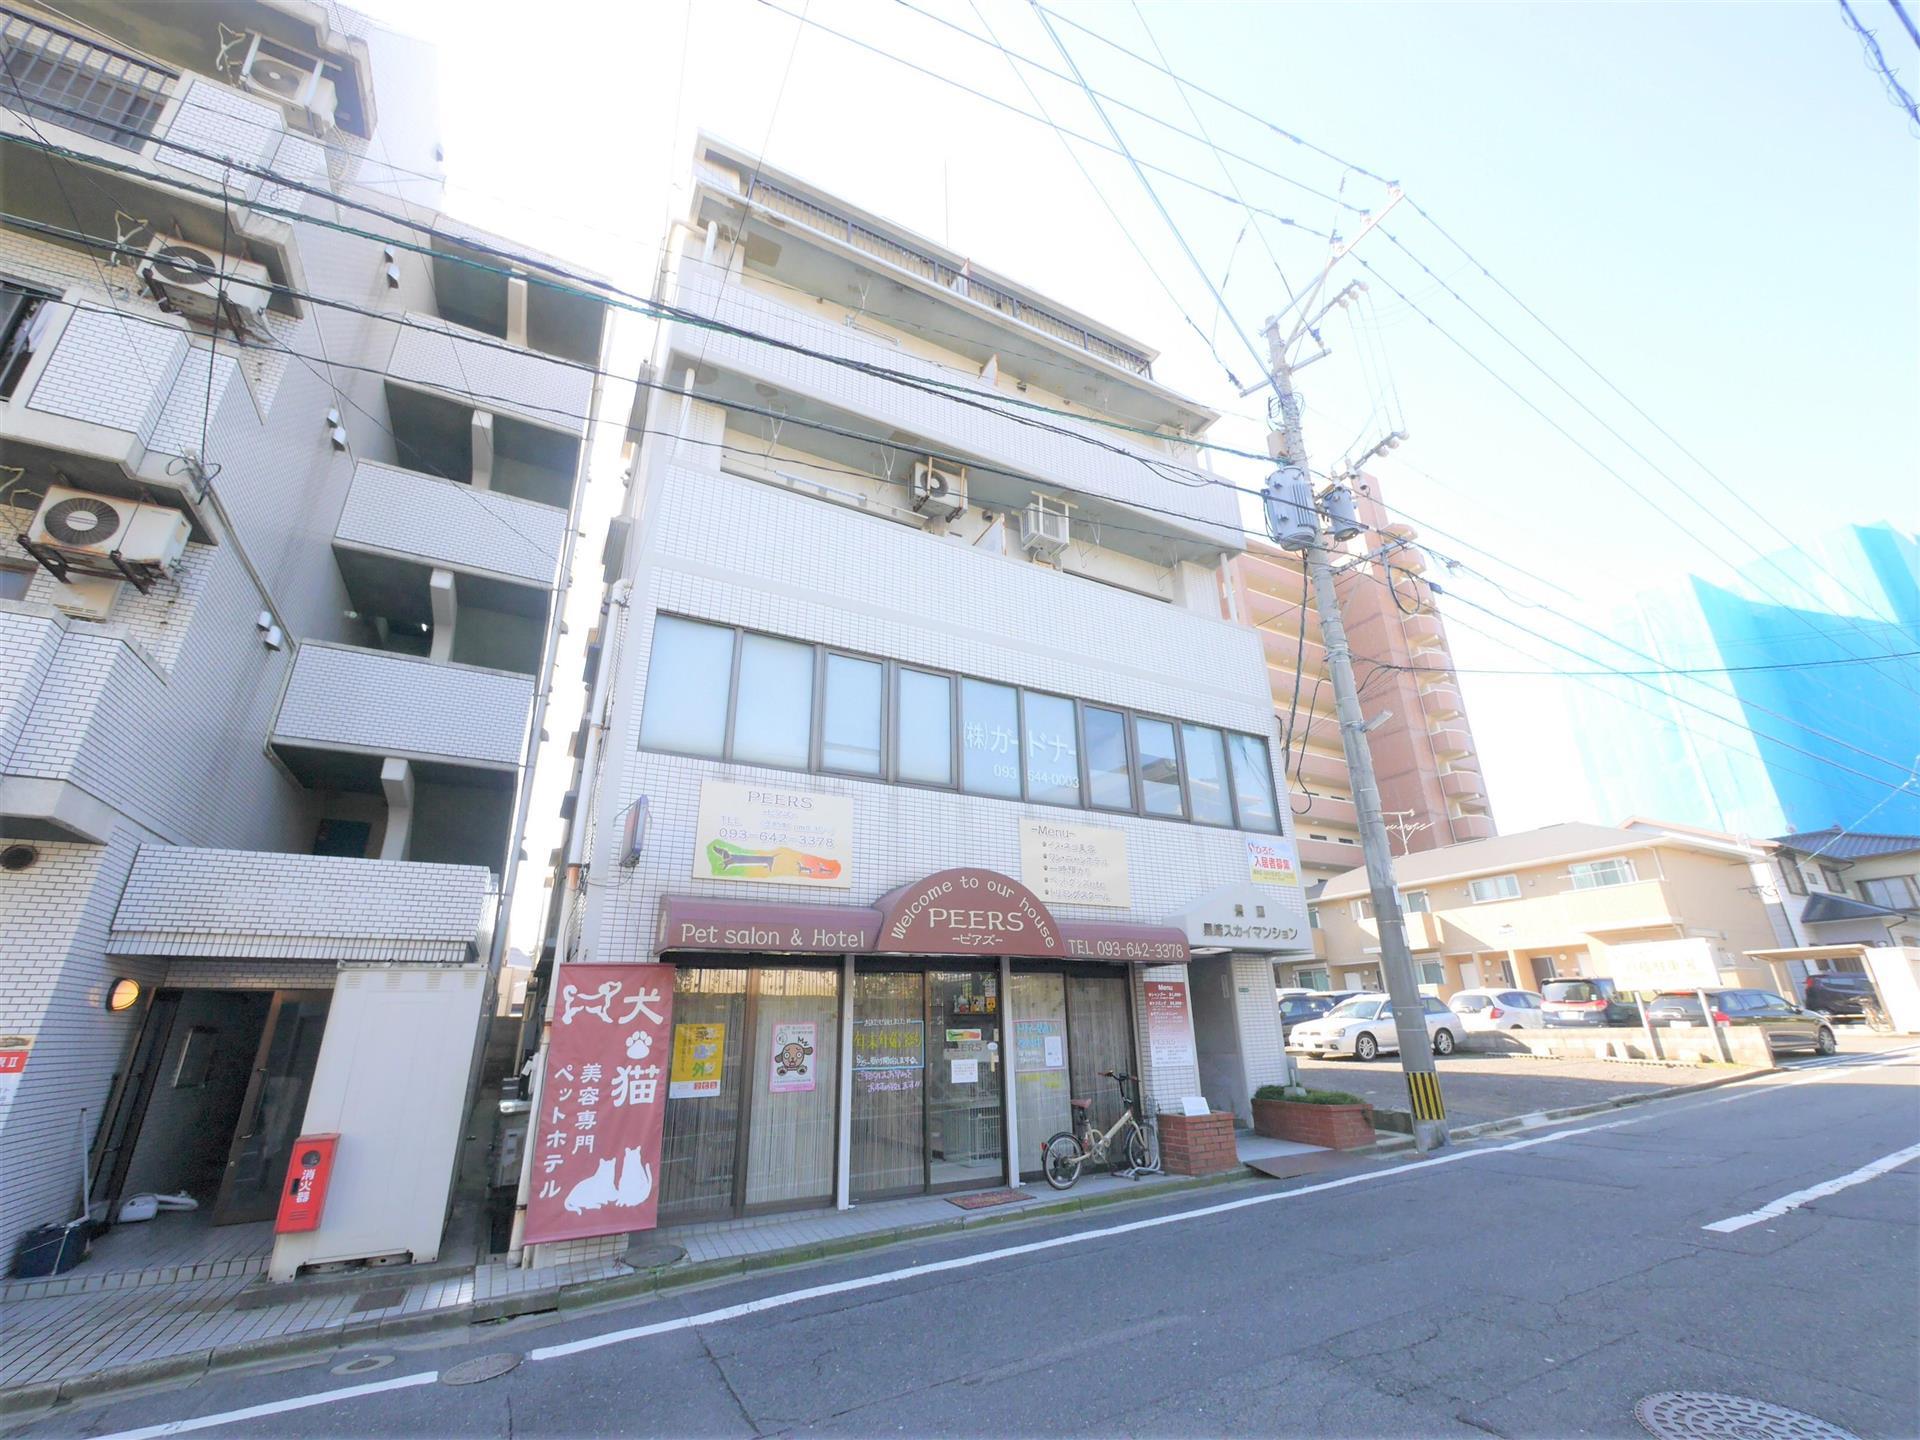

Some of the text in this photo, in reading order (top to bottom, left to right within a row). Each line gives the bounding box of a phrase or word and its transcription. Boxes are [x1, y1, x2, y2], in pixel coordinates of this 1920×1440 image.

[747, 790, 814, 809] PEERS
[719, 827, 835, 848] 093-642-3378
[891, 875, 1055, 949] Welcome to our house
[928, 908, 1024, 932] PEERS
[681, 923, 865, 948] Pet salon & Hotel
[1067, 939, 1184, 958] TEL 093-642-3378
[611, 987, 664, 1108] 犬 猫
[572, 1063, 603, 1155] 美容専門
[539, 1063, 575, 1199] ペットホテル
[295, 1169, 316, 1203] 消火器
